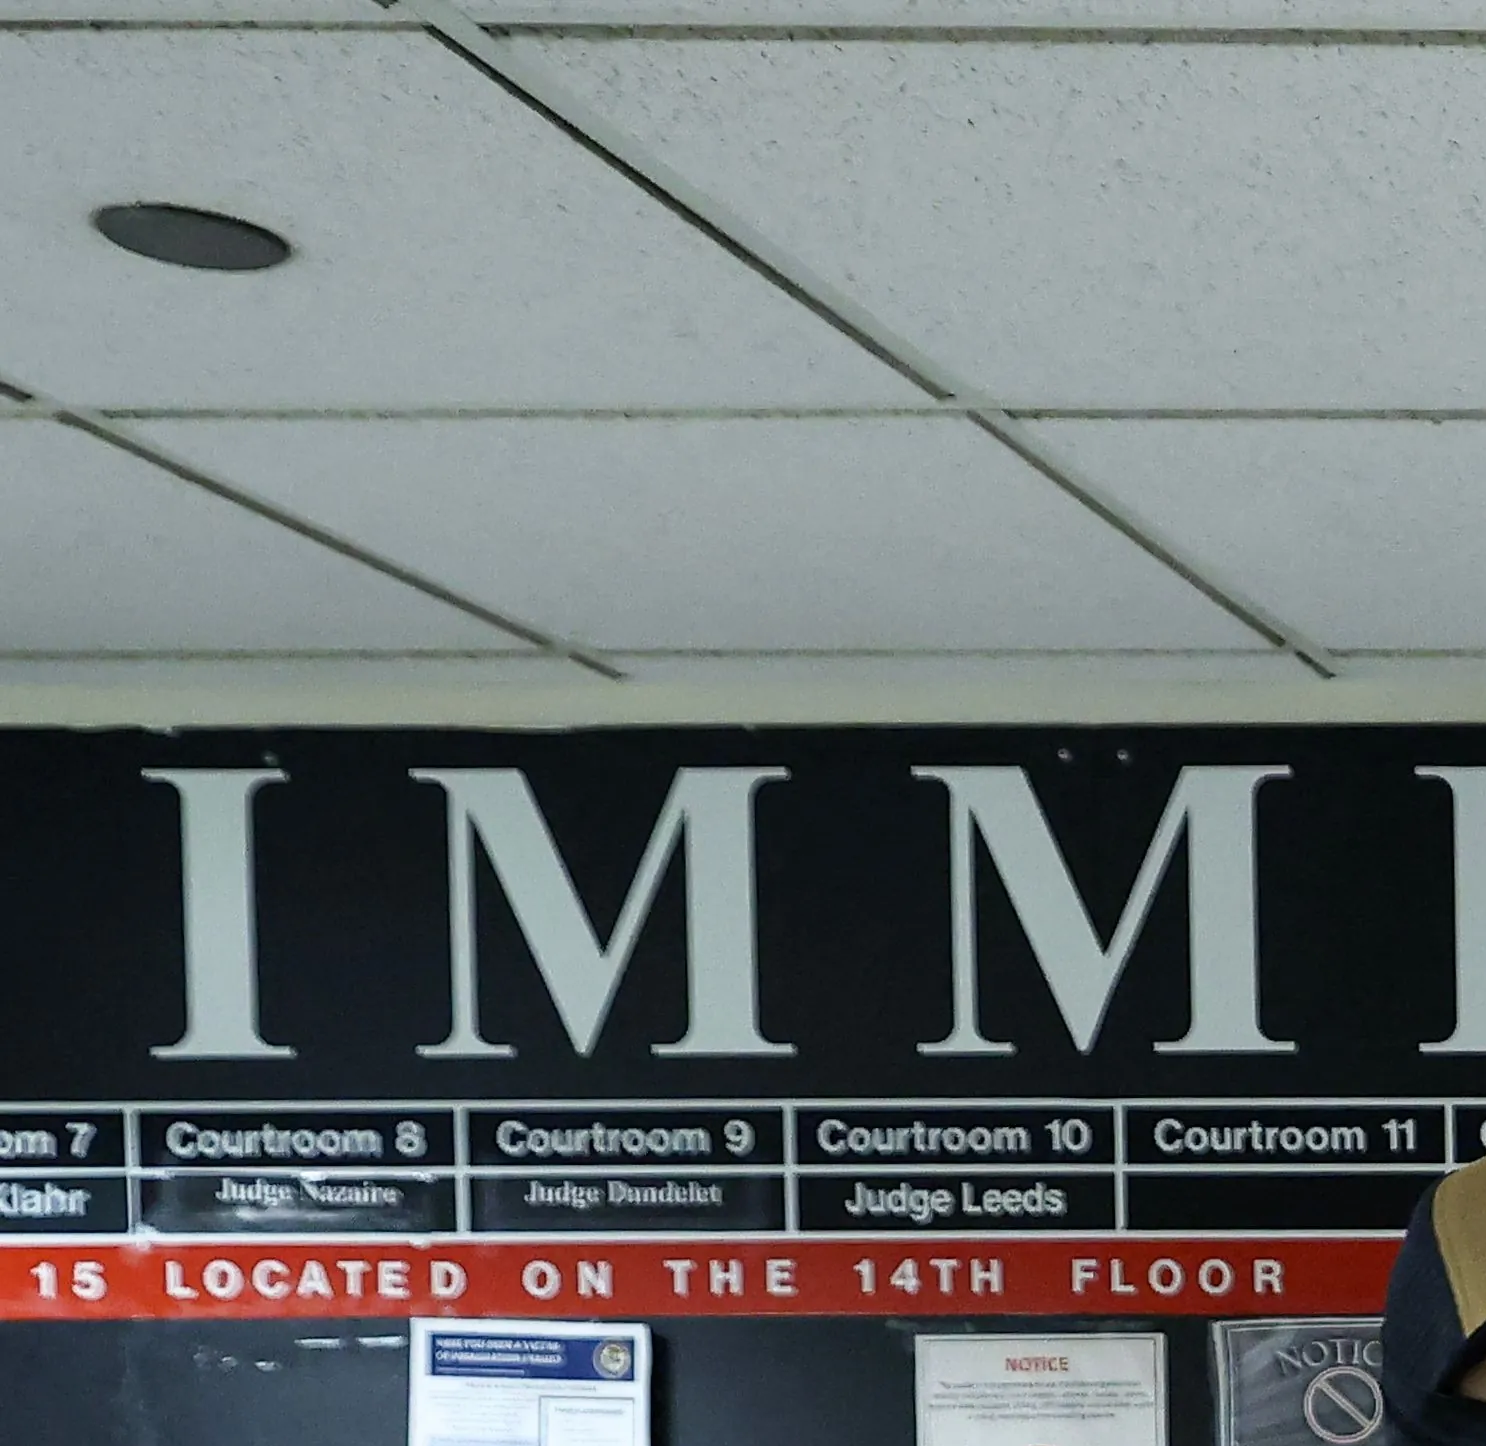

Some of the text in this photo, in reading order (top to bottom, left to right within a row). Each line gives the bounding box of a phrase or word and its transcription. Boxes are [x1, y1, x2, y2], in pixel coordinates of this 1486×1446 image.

[66, 1123, 96, 1157] 7
[166, 1121, 425, 1158] Courtroom 8
[497, 1120, 752, 1155] Courtroom 9
[818, 1119, 1090, 1153] Courtroom 10
[1154, 1119, 1414, 1152] Courtroom 11
[215, 1177, 293, 1206] Judge
[524, 1181, 602, 1209] Judge
[845, 1182, 1066, 1222] Judge Leeds
[31, 1259, 1281, 1300] 15 LOCATED ON THE 14TH FLOOR
[1006, 1357, 1068, 1371] NOTICE
